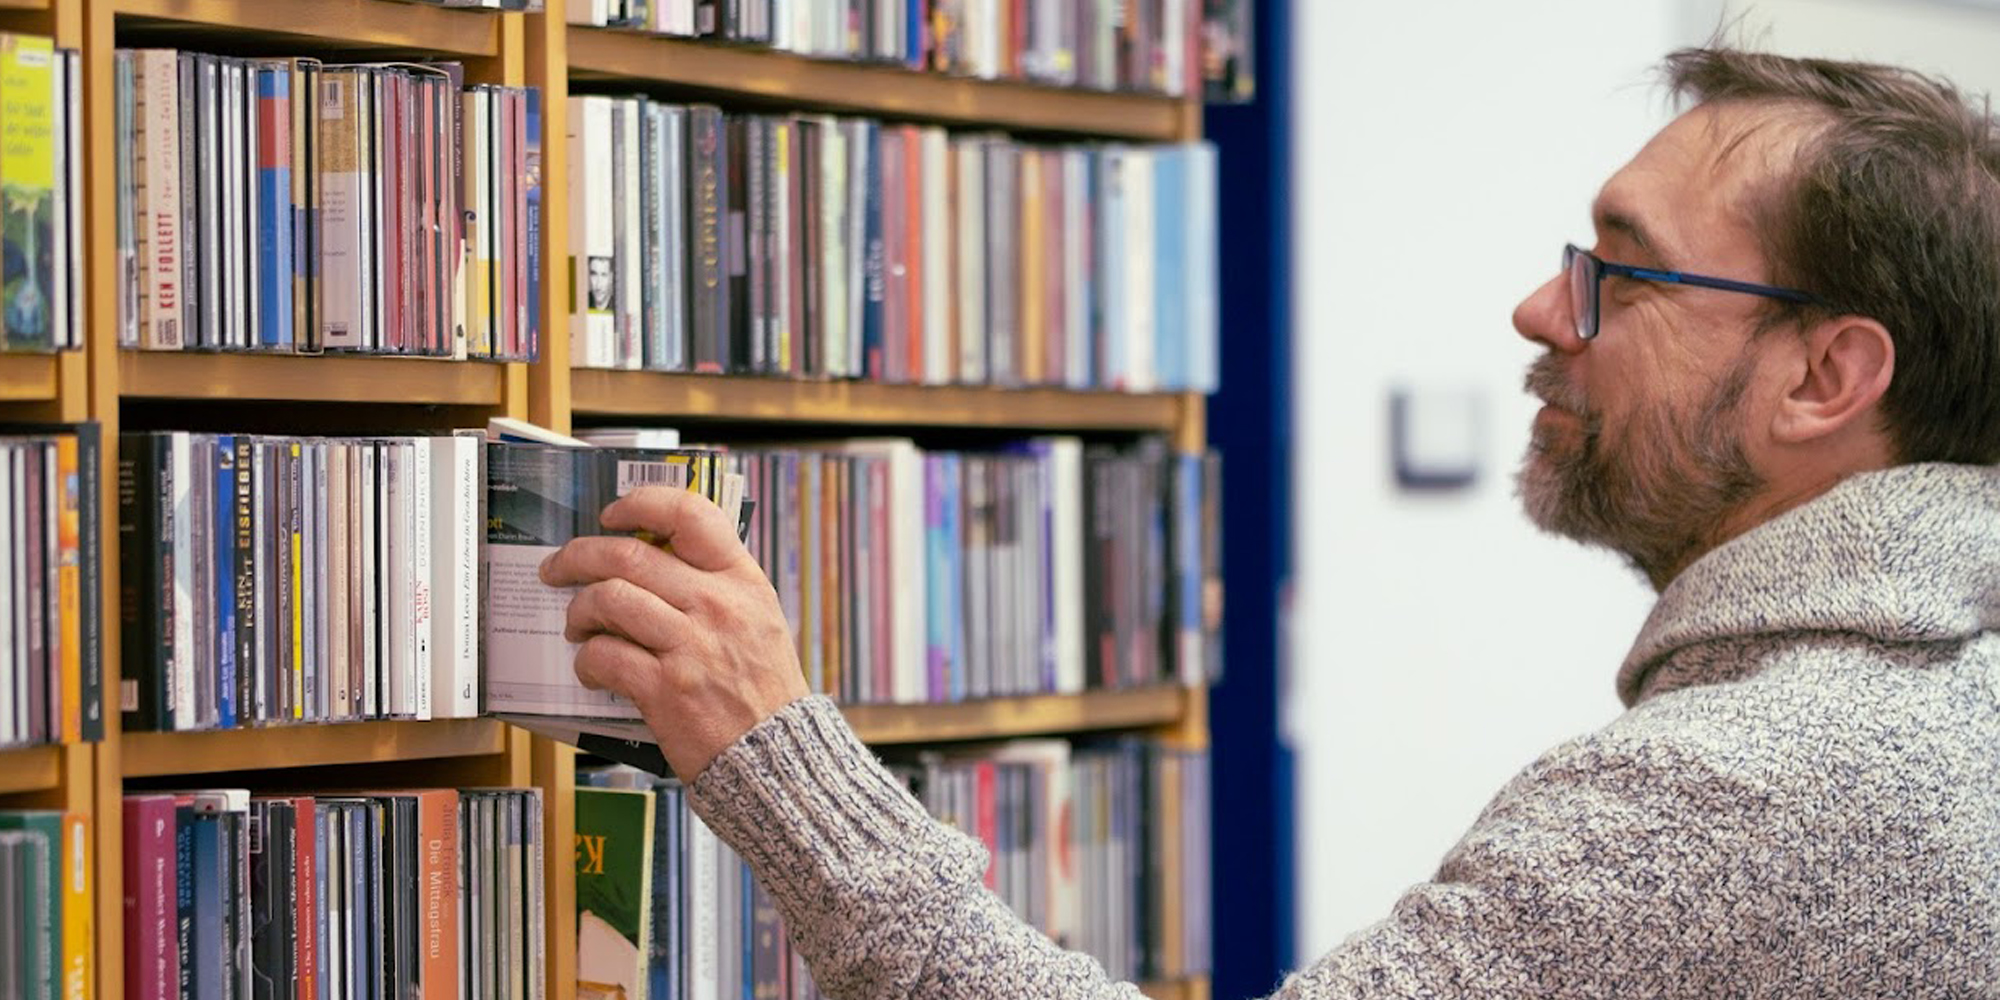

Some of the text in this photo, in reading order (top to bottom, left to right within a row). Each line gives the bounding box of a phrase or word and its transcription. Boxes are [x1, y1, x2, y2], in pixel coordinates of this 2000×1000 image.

[160, 62, 171, 121] Zwilling
[157, 213, 174, 273] FOLLETT
[158, 283, 175, 309] KEN
[237, 443, 251, 549] EISFIEBER
[418, 448, 428, 567] DORNENKLEID
[461, 458, 472, 523] Geschichten
[462, 537, 471, 569] Leben
[237, 576, 247, 609] KEN
[244, 556, 254, 628] FOLLETT
[462, 593, 471, 620] Leon
[462, 624, 471, 659] Donna
[442, 804, 455, 899] Julia Franck
[290, 906, 298, 939] Leon
[427, 839, 443, 960] Die Mittagsfrau
[181, 916, 191, 987] Worte in
